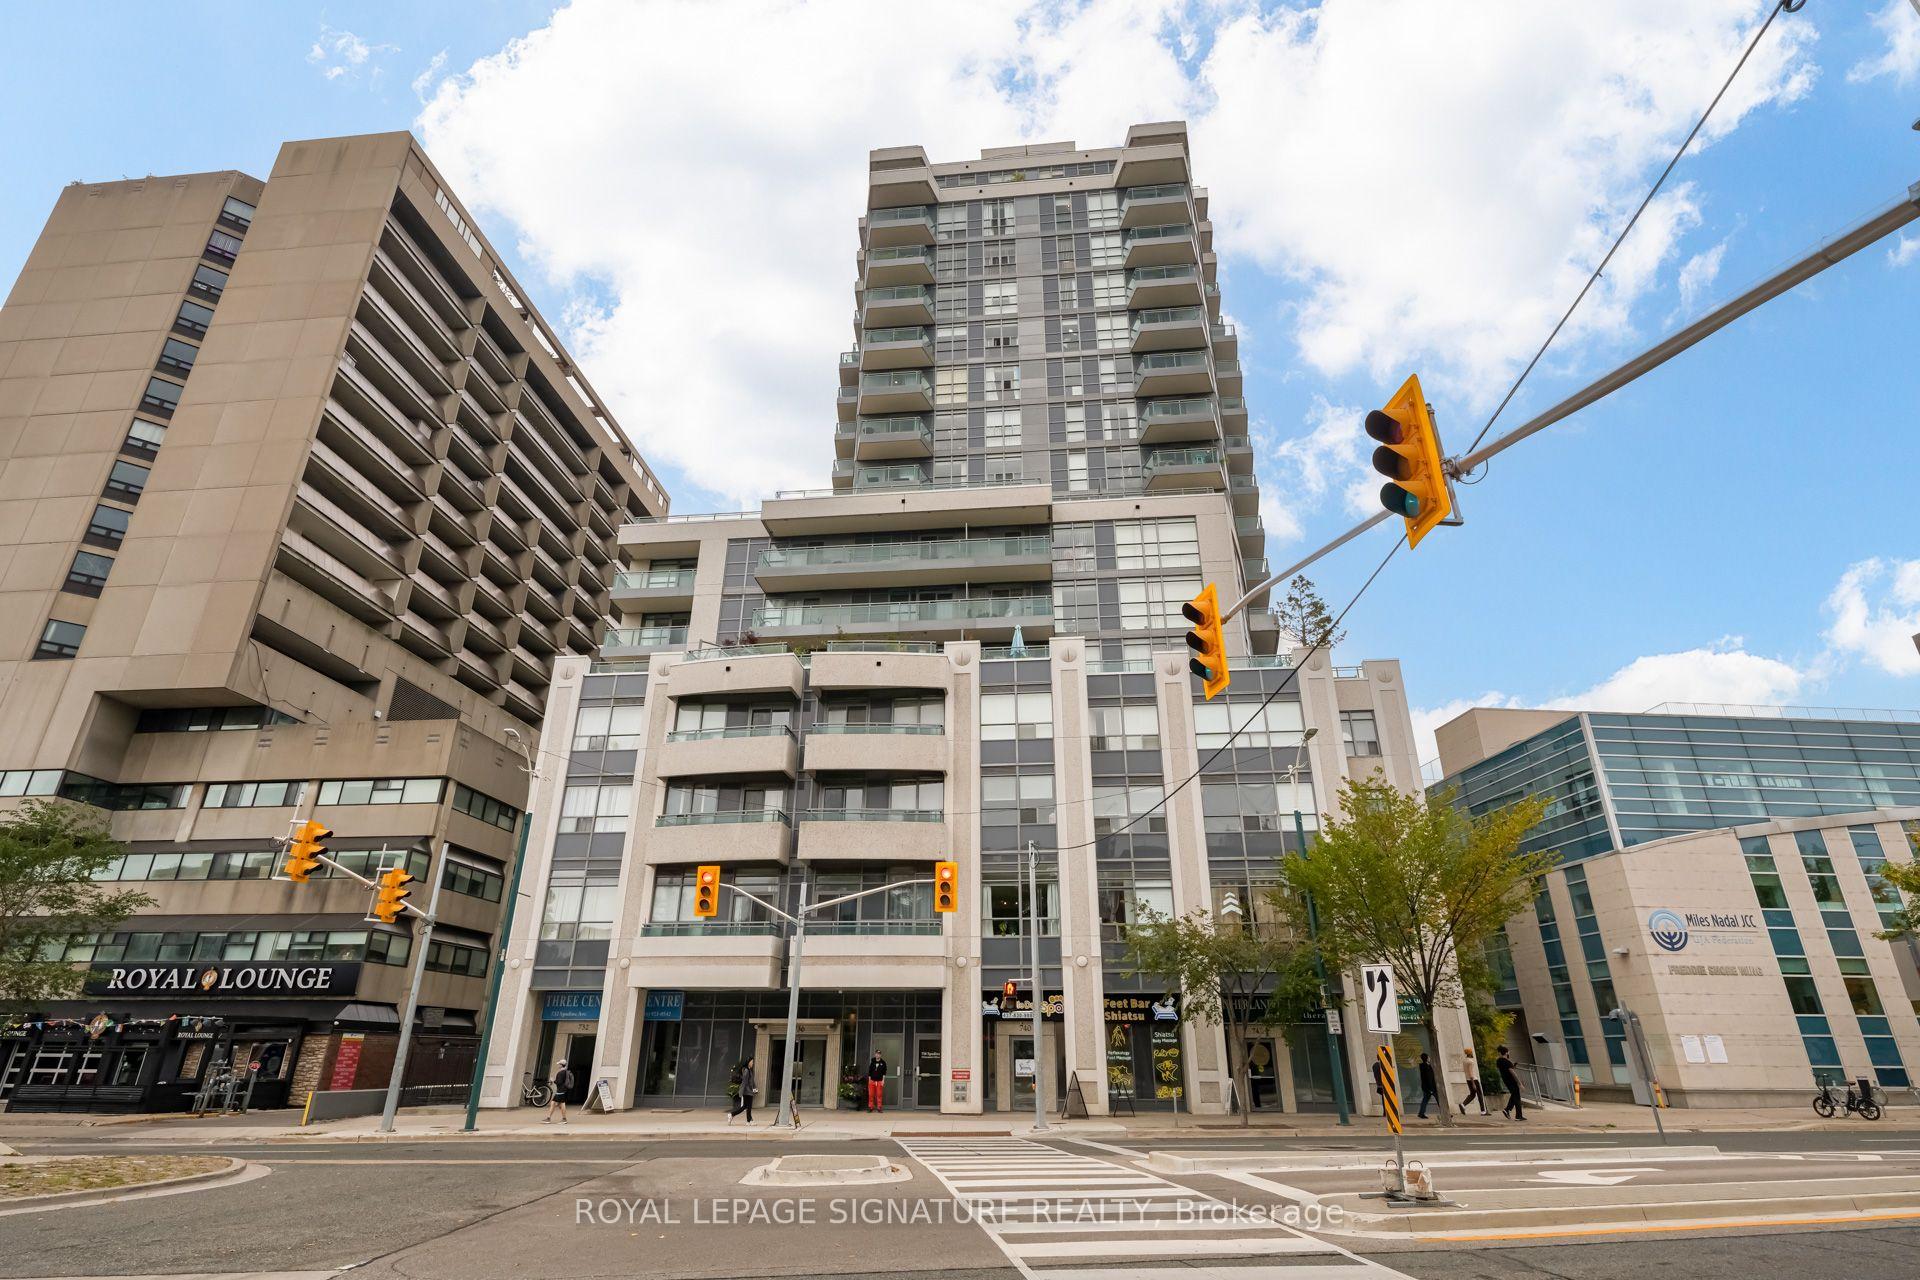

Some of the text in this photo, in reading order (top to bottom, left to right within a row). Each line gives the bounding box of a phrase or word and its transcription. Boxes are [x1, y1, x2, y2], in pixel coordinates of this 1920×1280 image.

[1685, 914, 1756, 928] Miles Nadal JCC
[107, 967, 332, 989] ROYAL LOUNGE
[546, 994, 681, 1007] THREE CEN ENTRE
[1103, 999, 1150, 1009] Feet Bar
[1105, 1011, 1145, 1021] Shiatsu
